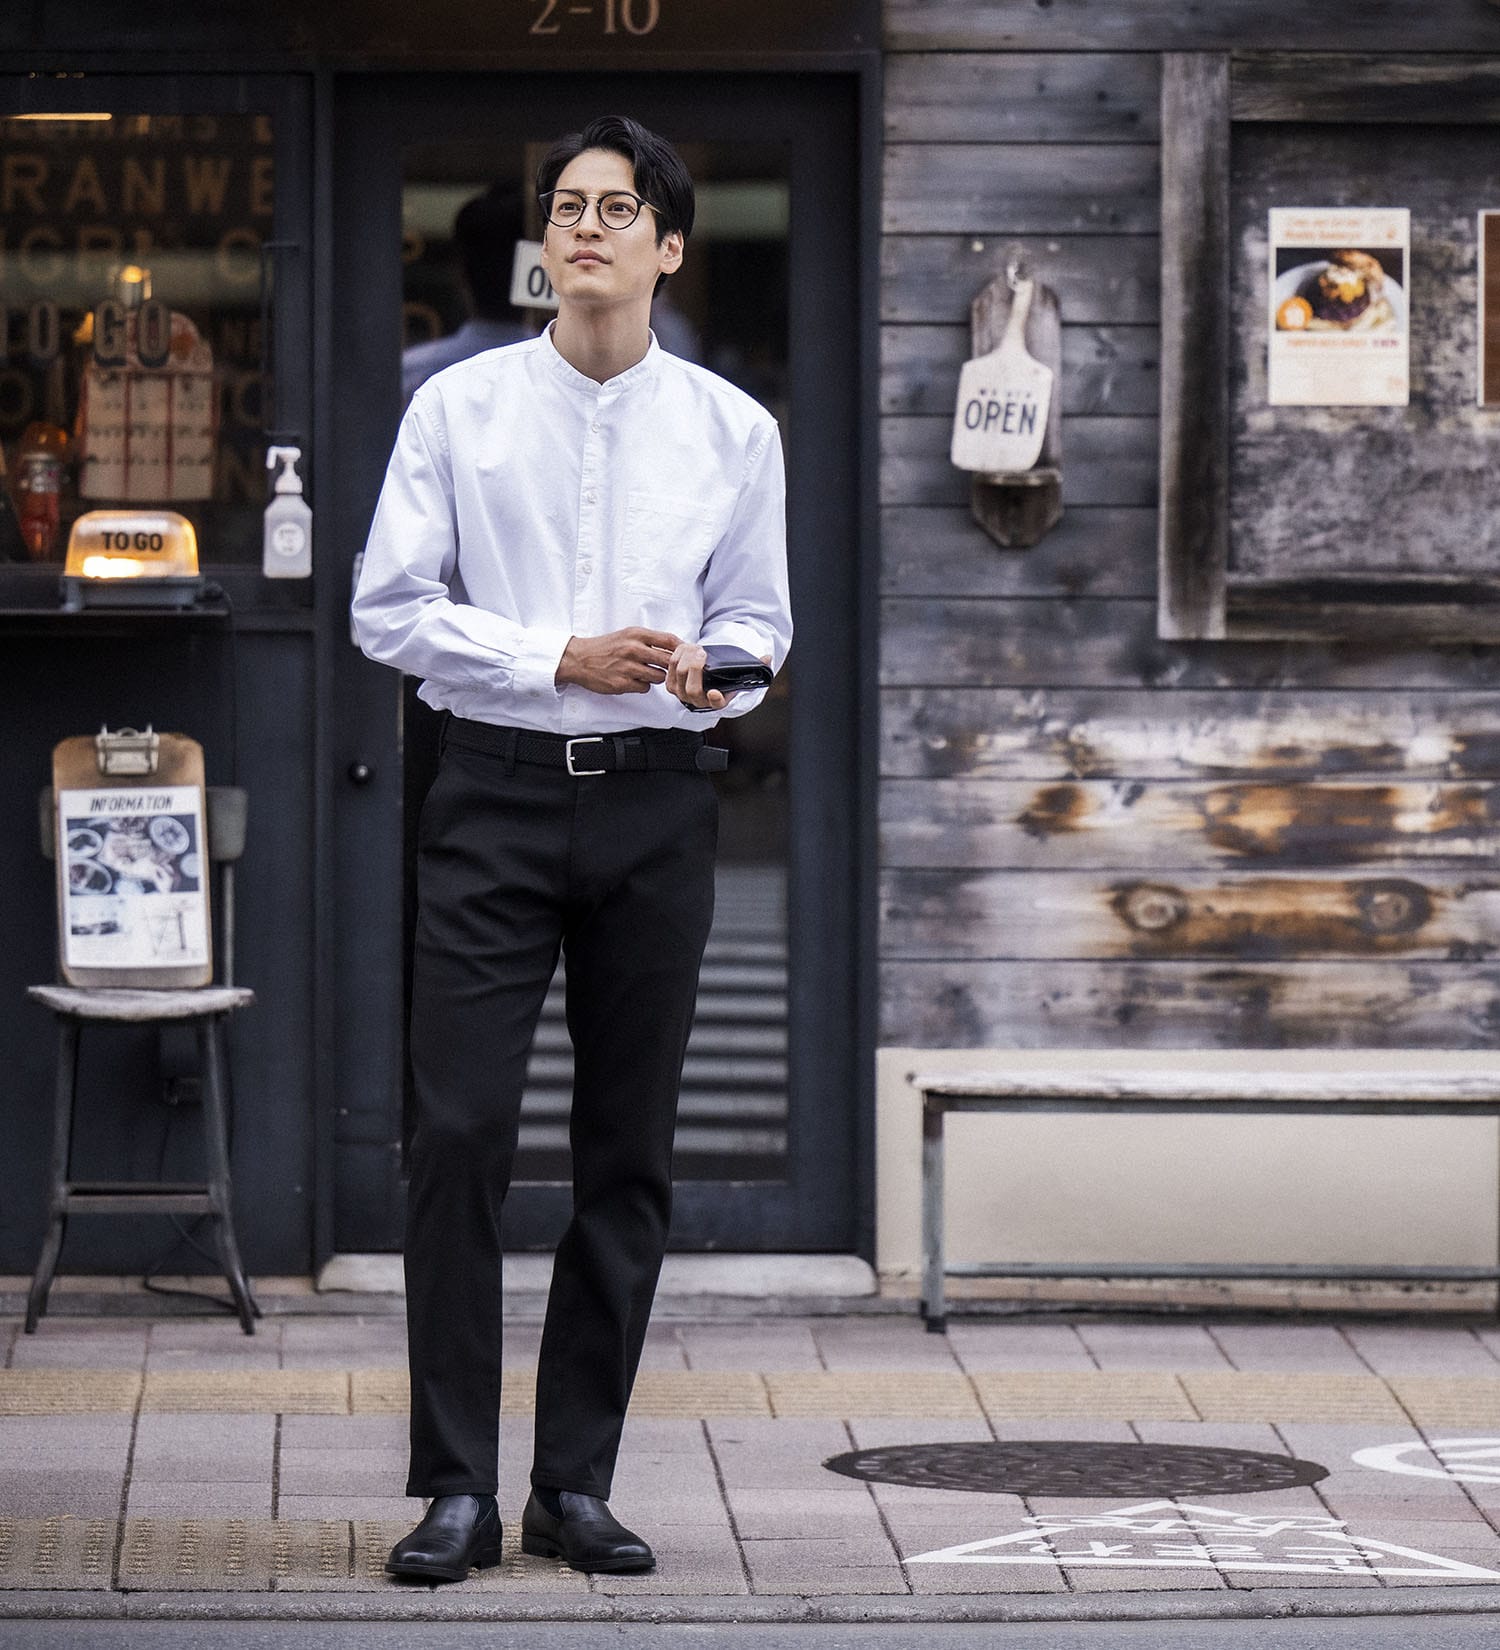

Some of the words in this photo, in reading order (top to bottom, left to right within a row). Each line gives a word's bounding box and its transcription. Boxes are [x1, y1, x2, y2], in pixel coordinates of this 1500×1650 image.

[965, 399, 1037, 434] OPEN
[101, 532, 129, 551] TO
[134, 532, 163, 552] GO
[90, 794, 173, 812] INFORMATION
